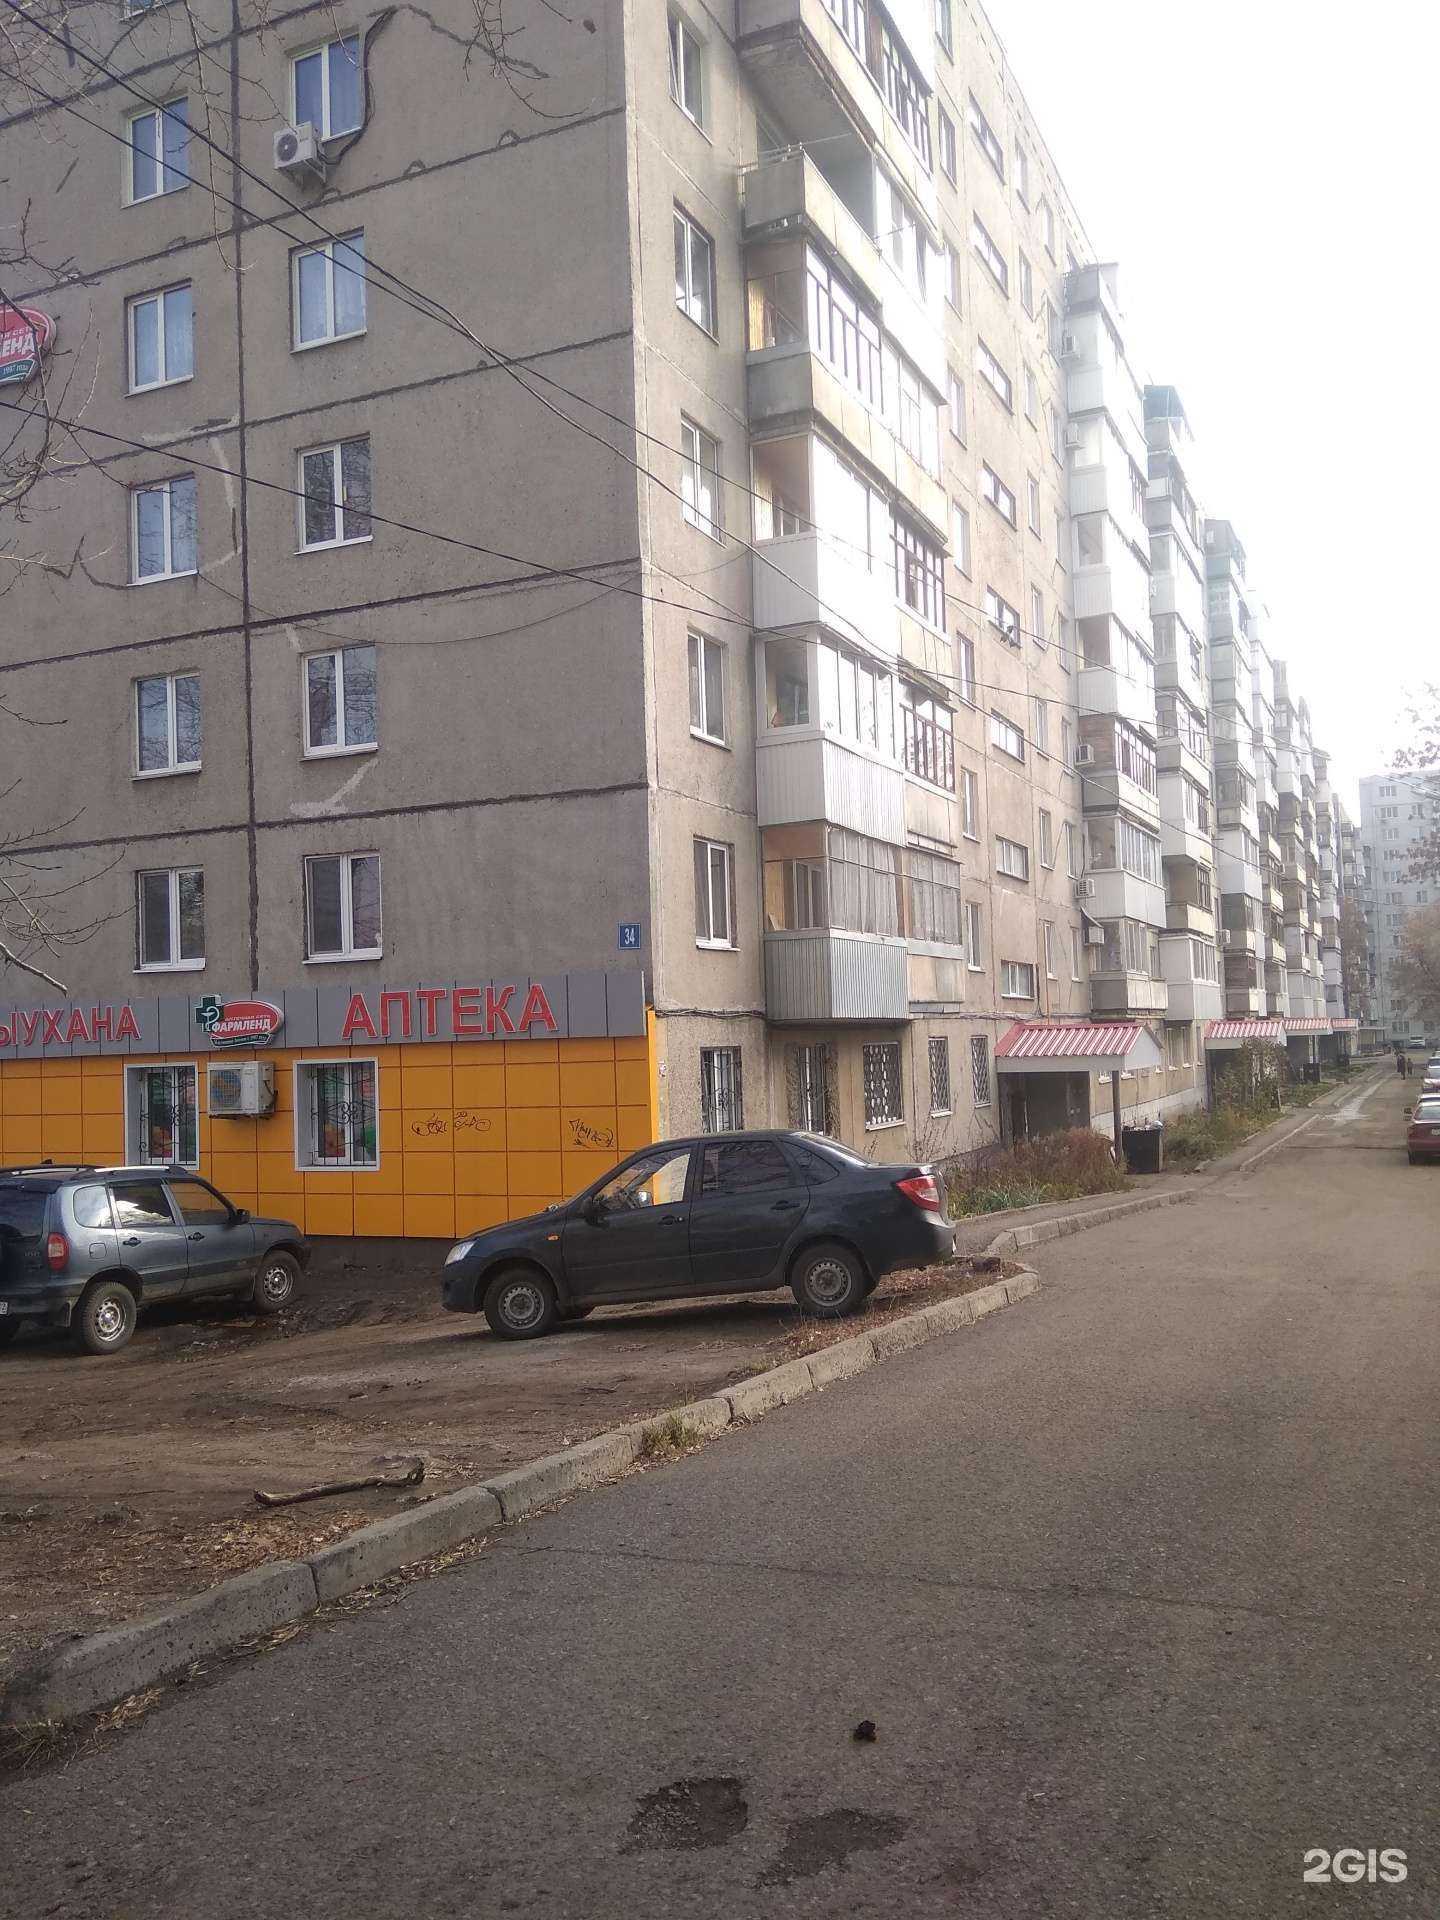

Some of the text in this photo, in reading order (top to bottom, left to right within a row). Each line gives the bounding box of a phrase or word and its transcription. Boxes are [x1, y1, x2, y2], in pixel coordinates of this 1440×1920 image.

[624, 928, 636, 944] 34
[341, 982, 559, 1040] АПТЕКА
[211, 1018, 271, 1033] ФАРМЛЕНД
